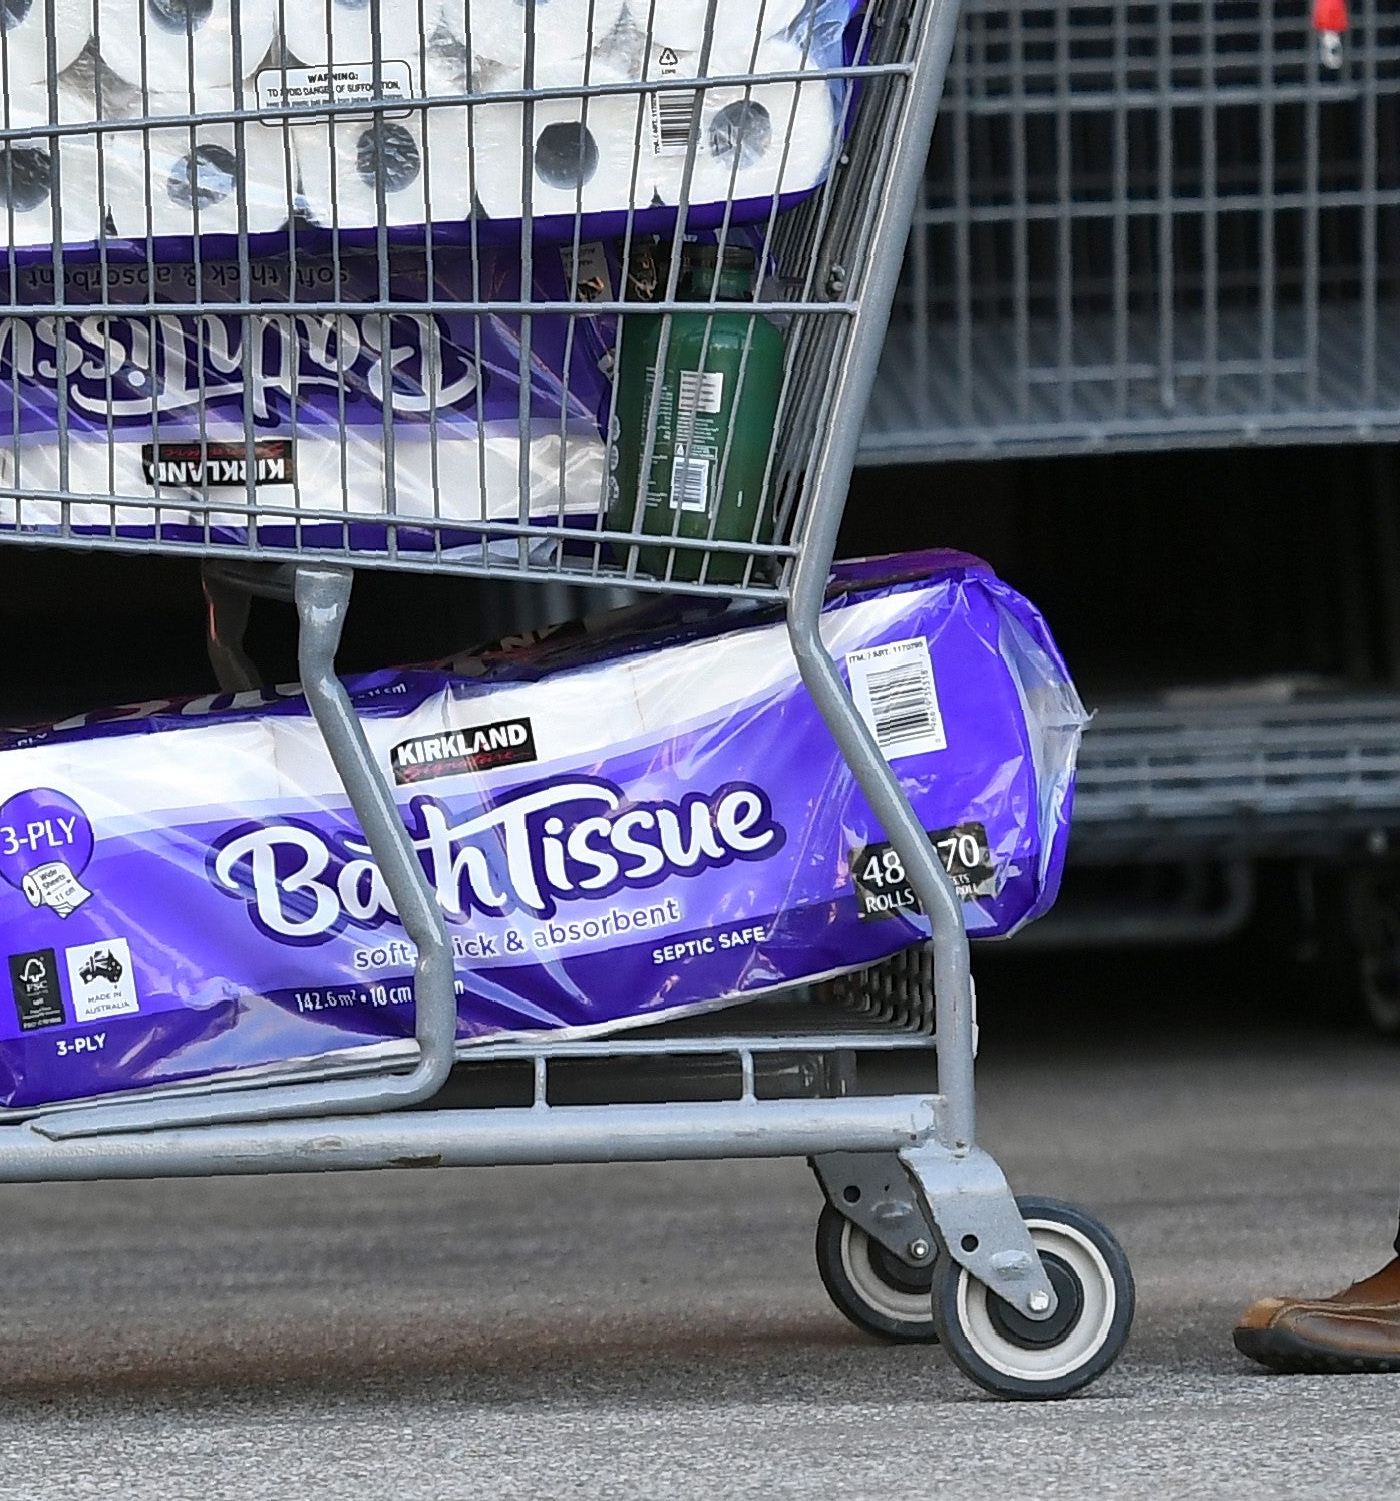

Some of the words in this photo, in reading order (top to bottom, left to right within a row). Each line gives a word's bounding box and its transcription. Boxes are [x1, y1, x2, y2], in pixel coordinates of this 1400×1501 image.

[267, 88, 279, 98] TO
[336, 84, 345, 93] OF
[149, 457, 285, 484] KIRKLAND
[398, 723, 528, 766] KIRKLAND
[0, 816, 76, 855] 3-PLY
[216, 803, 506, 937] Bath
[492, 783, 775, 911] Tissue
[862, 850, 905, 888] 48
[865, 888, 915, 913] ROLLS
[505, 930, 525, 951] &
[534, 900, 680, 949] absorbent
[652, 937, 715, 964] SEPTIC
[718, 926, 766, 949] SAFE
[26, 980, 48, 992] FSC
[87, 992, 111, 1003] MADE
[369, 986, 387, 1007] 10
[389, 985, 412, 1005] cm
[85, 1001, 130, 1015] AUSTRALIA
[56, 1032, 107, 1056] 3-PLY
